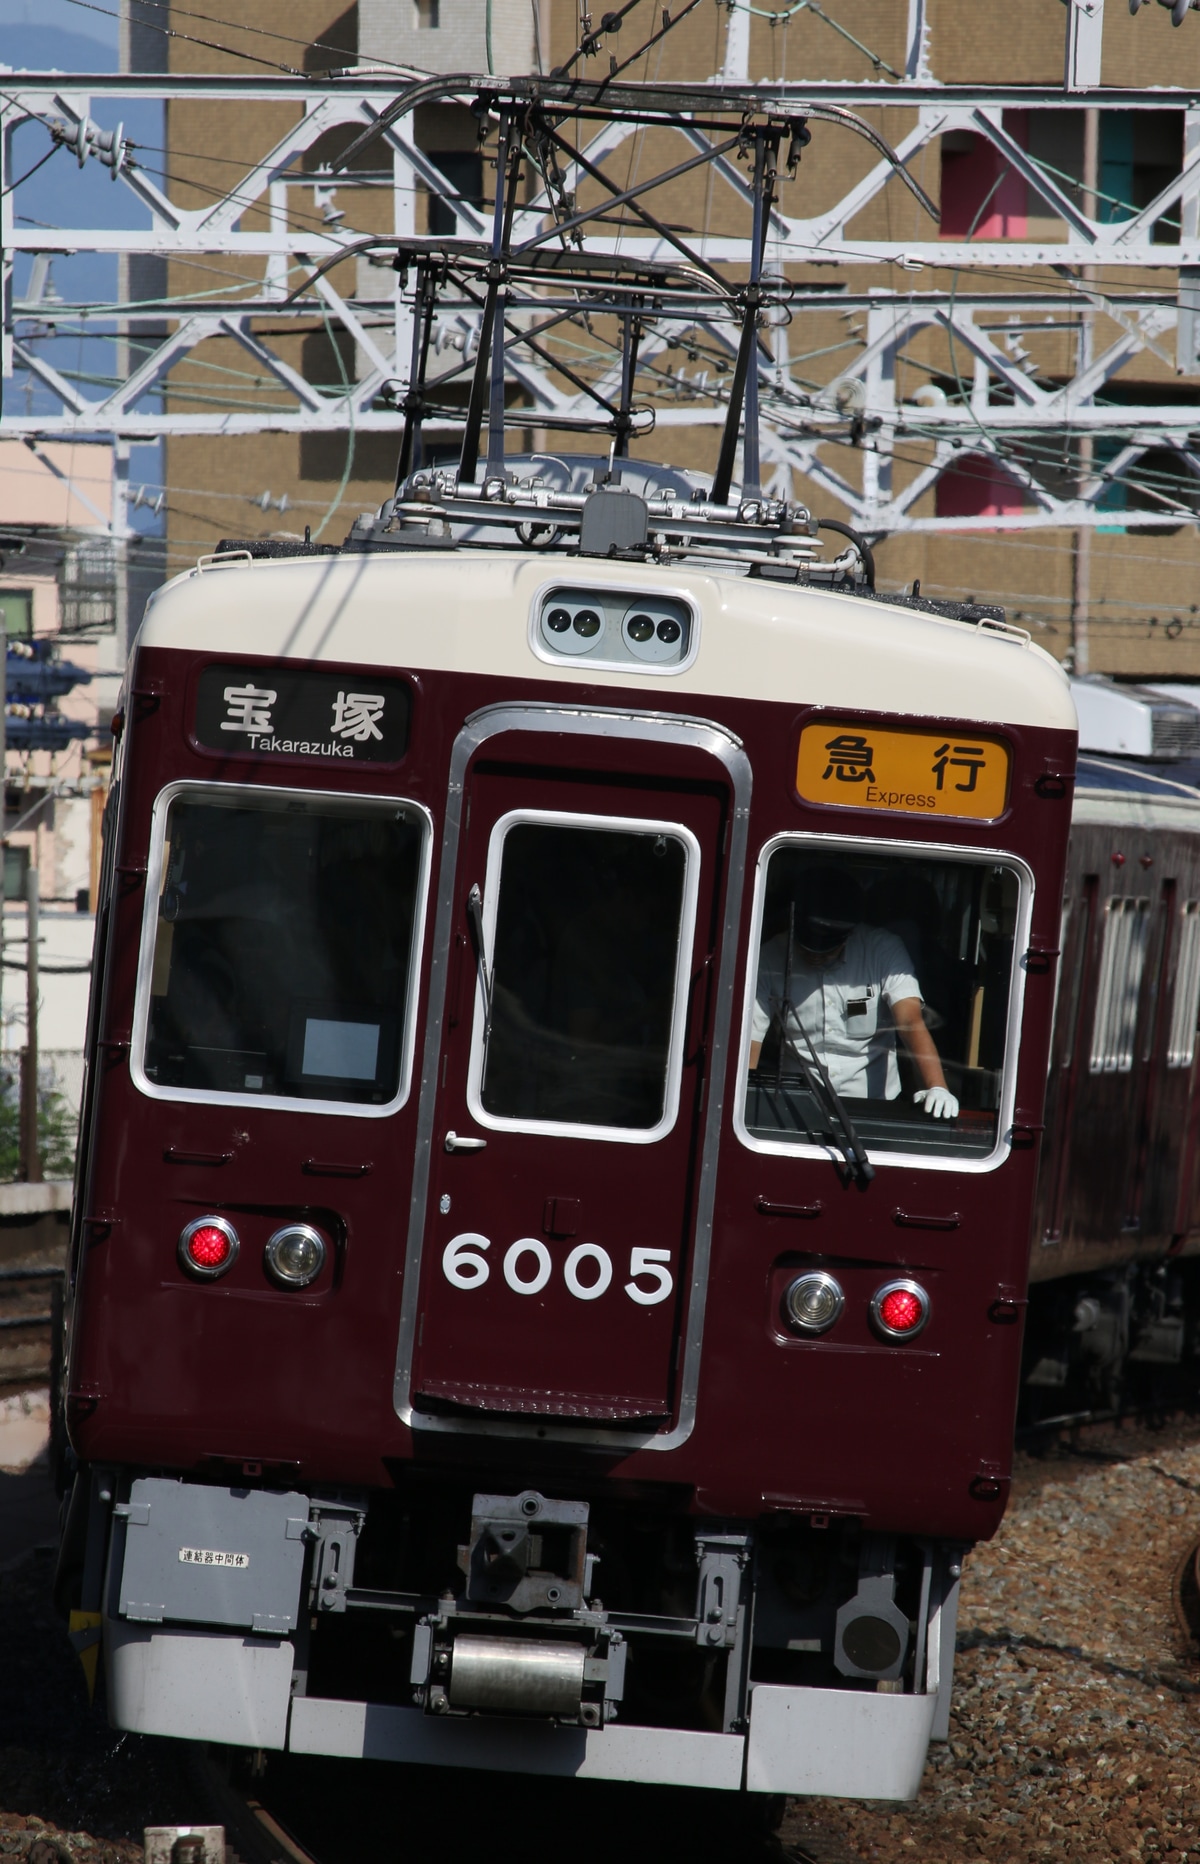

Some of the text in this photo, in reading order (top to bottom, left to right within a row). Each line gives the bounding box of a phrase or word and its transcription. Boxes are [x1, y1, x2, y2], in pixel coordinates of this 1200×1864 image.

[220, 683, 385, 741] 宝塚
[247, 733, 354, 757] Takarazuka
[822, 735, 986, 792] 急行
[866, 786, 936, 808] Express
[442, 1232, 673, 1305] 6005
[183, 1549, 245, 1567] 連結器中間体
